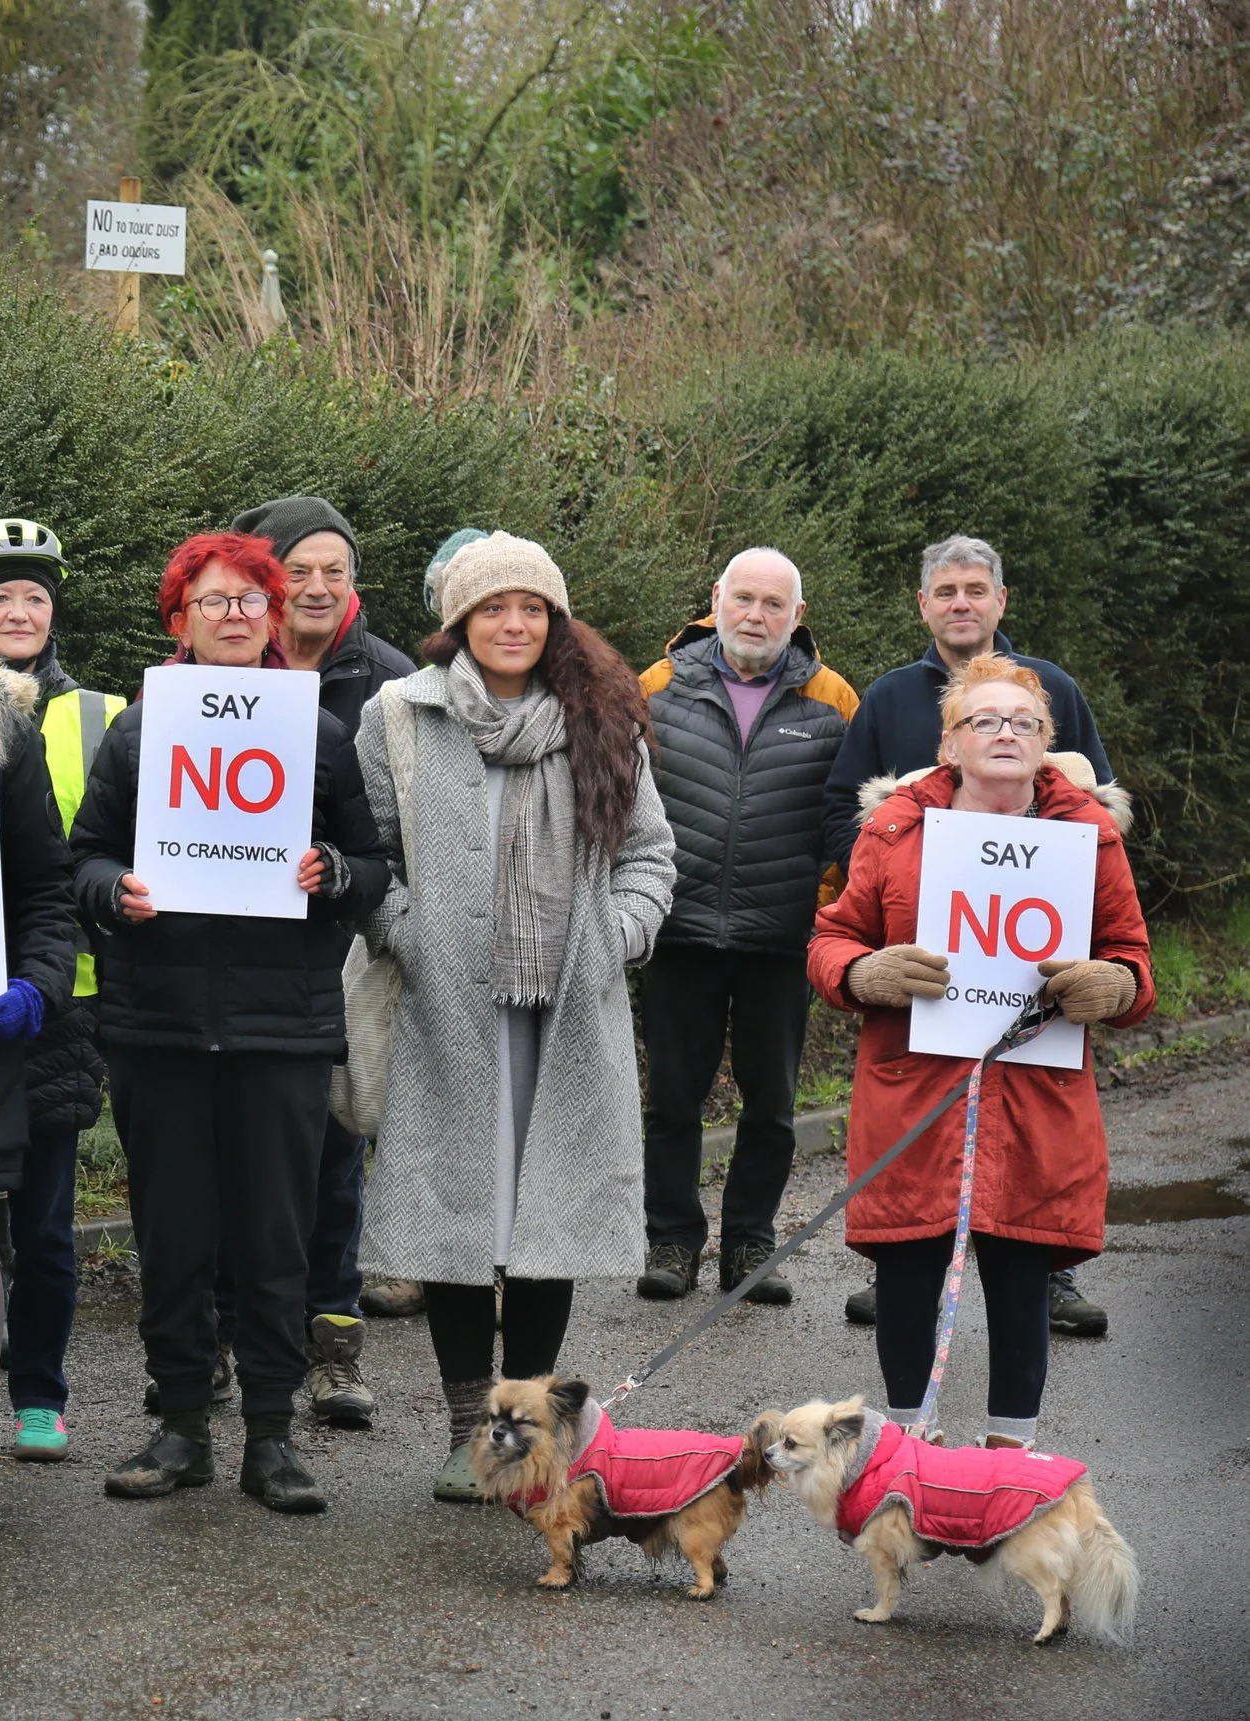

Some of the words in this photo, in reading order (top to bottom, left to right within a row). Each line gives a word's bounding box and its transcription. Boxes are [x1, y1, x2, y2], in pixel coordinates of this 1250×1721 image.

[92, 208, 113, 228] NO
[116, 221, 127, 233] TO
[129, 221, 155, 236] TOXIC
[156, 224, 180, 238] DUST
[99, 243, 118, 257] BAD
[121, 245, 161, 260] ODOURS
[202, 693, 260, 720] SAY
[785, 728, 812, 739] Columbia
[169, 744, 286, 814] NO
[157, 841, 181, 857] TO
[186, 842, 288, 863] CRANSWICK
[981, 840, 1040, 869] SAY
[947, 890, 1063, 963] NO
[946, 986, 959, 1001] O
